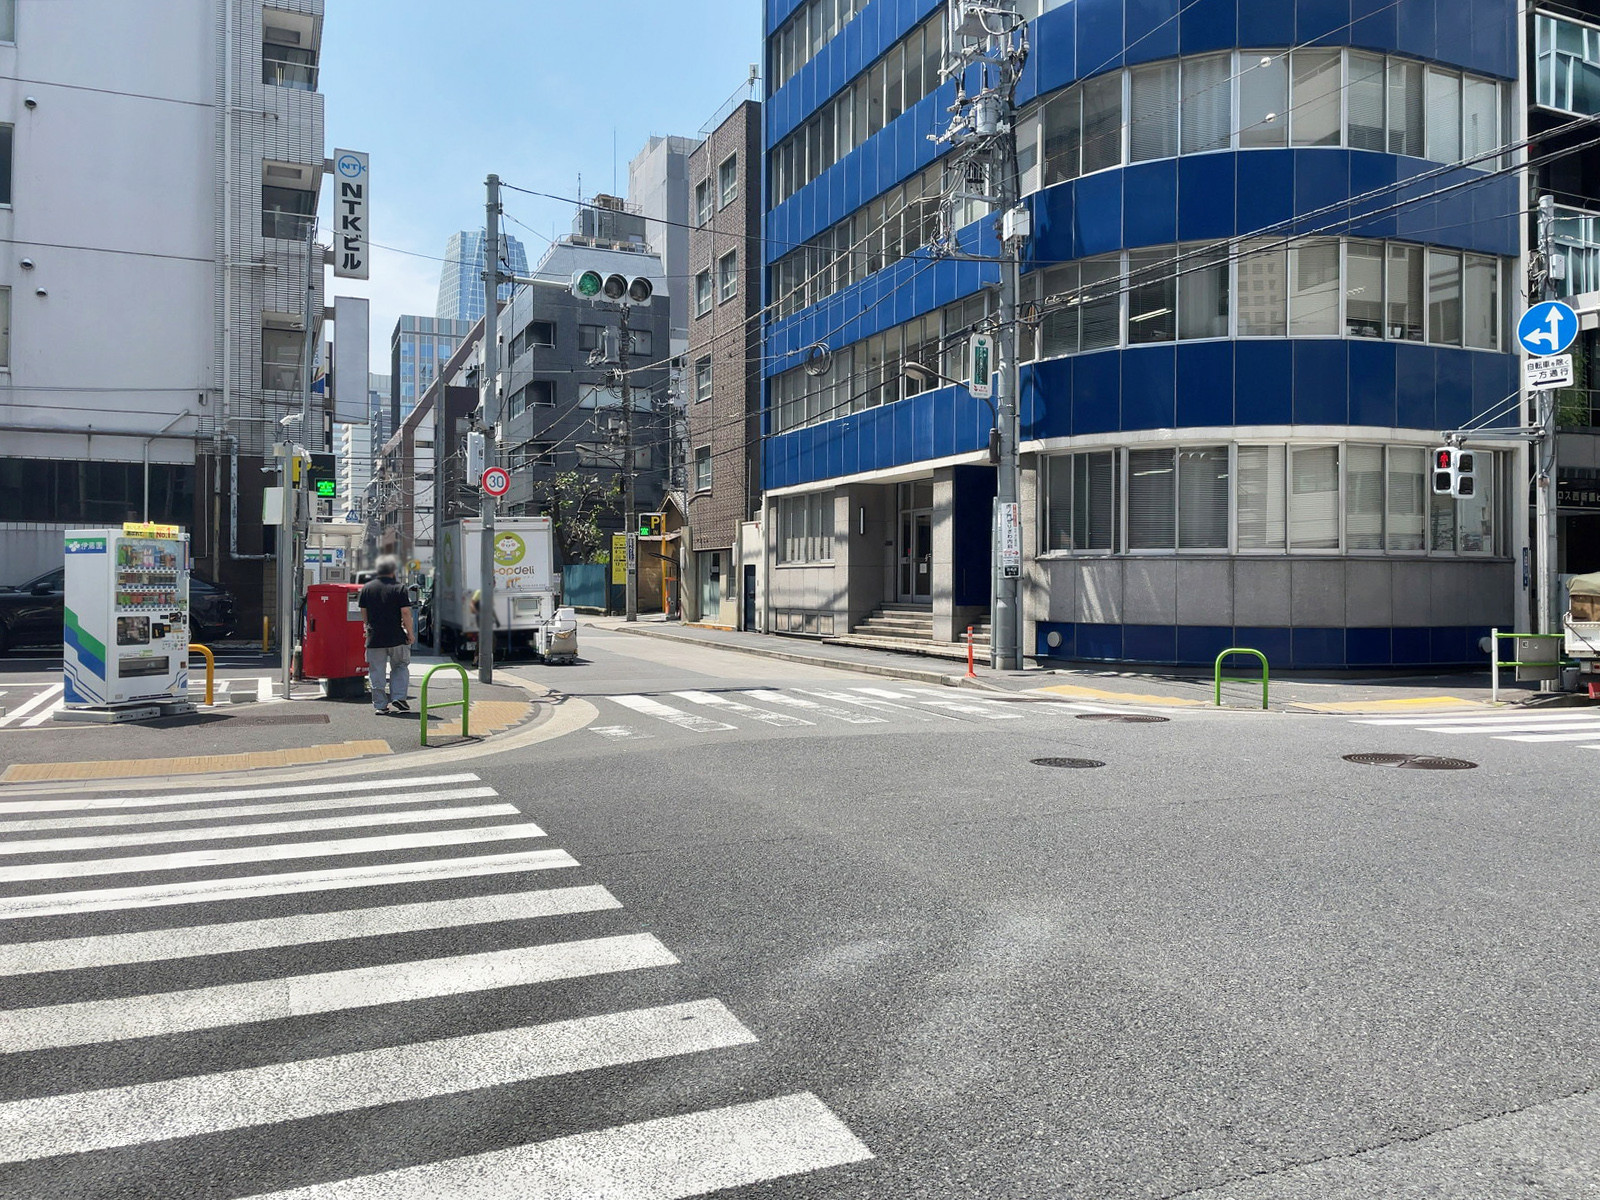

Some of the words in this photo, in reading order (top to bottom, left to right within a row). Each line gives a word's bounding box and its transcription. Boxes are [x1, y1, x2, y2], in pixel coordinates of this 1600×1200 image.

[341, 182, 362, 270] NTKビル
[1527, 358, 1569, 371] 自転車を除く
[1528, 368, 1569, 379] 一方通行
[489, 475, 505, 489] 30
[651, 516, 660, 529] P
